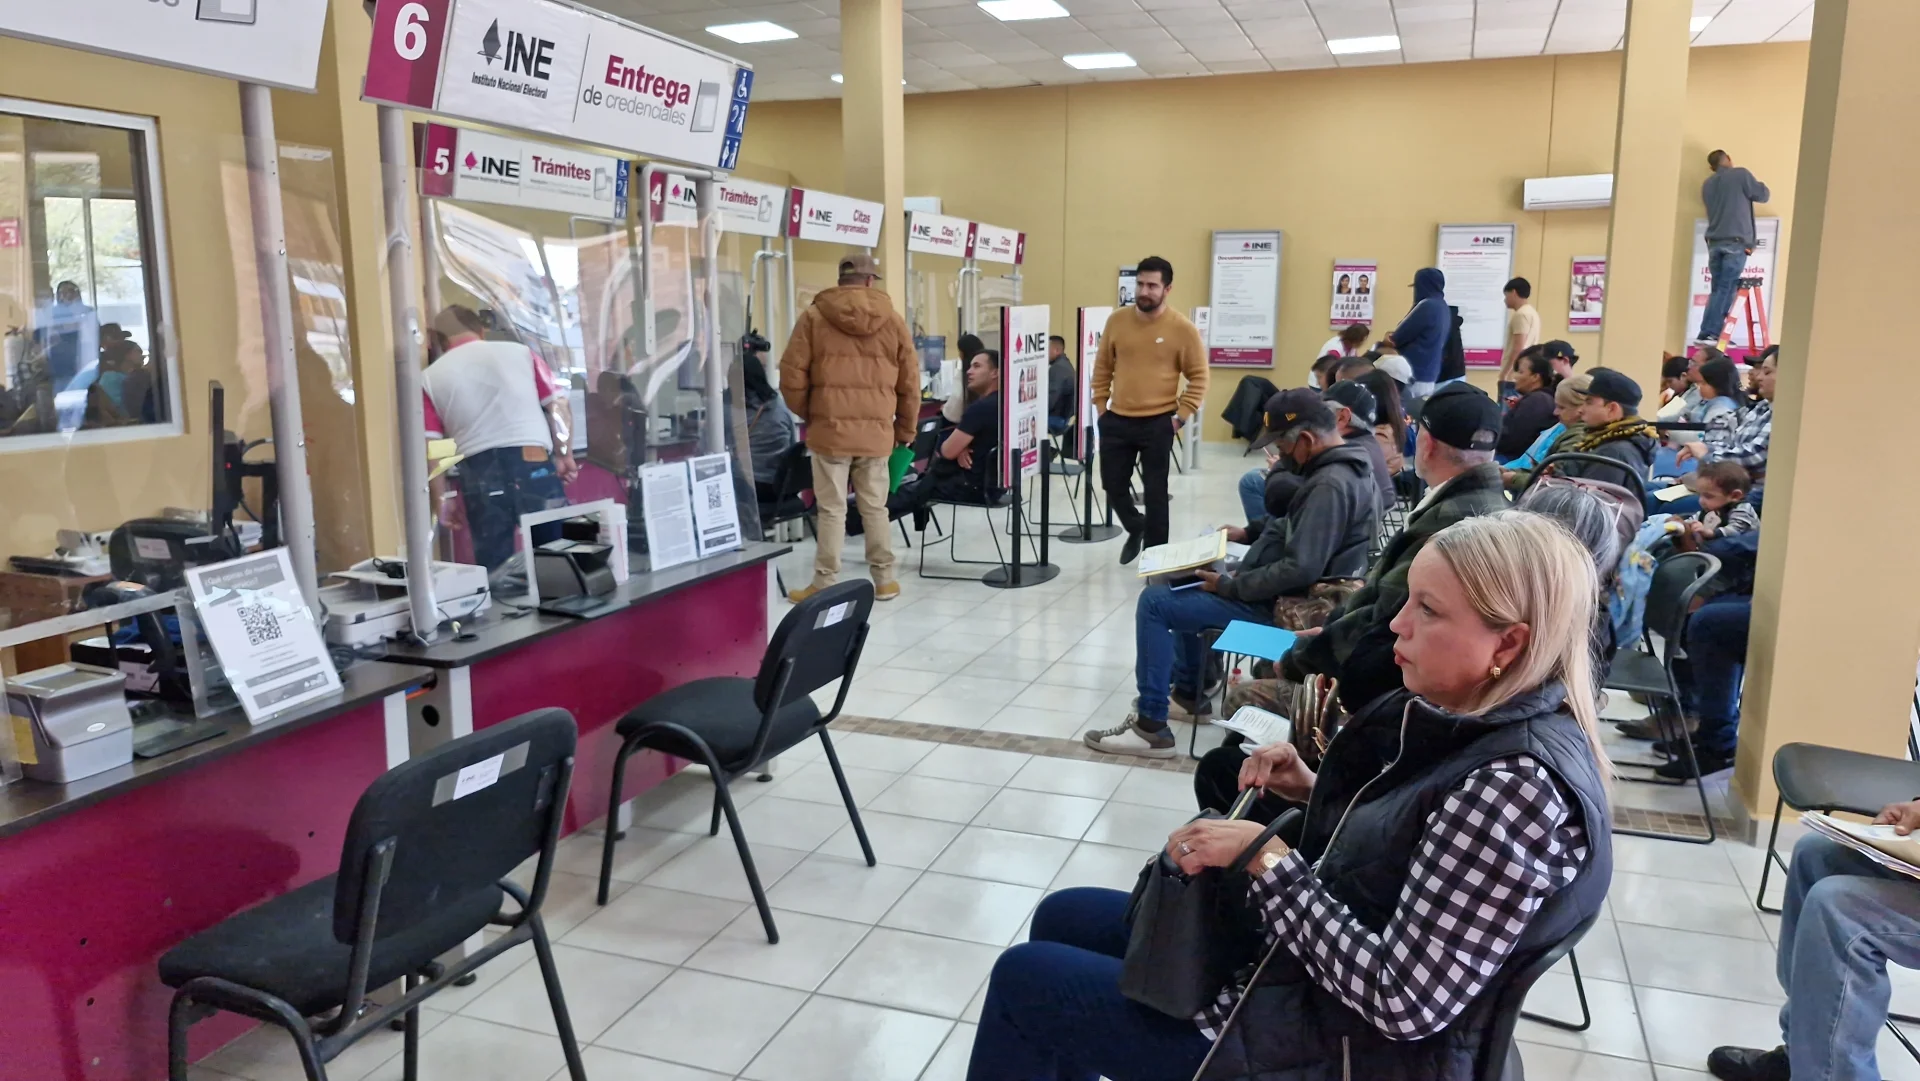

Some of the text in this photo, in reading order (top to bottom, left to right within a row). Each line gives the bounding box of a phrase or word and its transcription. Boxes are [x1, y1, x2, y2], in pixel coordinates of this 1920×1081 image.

[393, 2, 430, 60] 6
[504, 30, 555, 81] INE
[471, 71, 548, 99] Instituto Nacional Electoral
[604, 54, 691, 108] Entrega
[583, 85, 687, 126] de credenciales
[433, 147, 450, 176] 5
[481, 156, 520, 179] INE
[531, 155, 592, 182] Trámites
[651, 183, 662, 205] 4
[683, 187, 697, 204] IN
[719, 187, 759, 207] Trámites
[792, 203, 801, 223] 3
[815, 209, 833, 223] INE
[852, 209, 871, 224] Citas
[836, 223, 869, 235] programadas
[1482, 236, 1505, 244] INE
[967, 233, 975, 248] 2
[1025, 332, 1045, 354] INE
